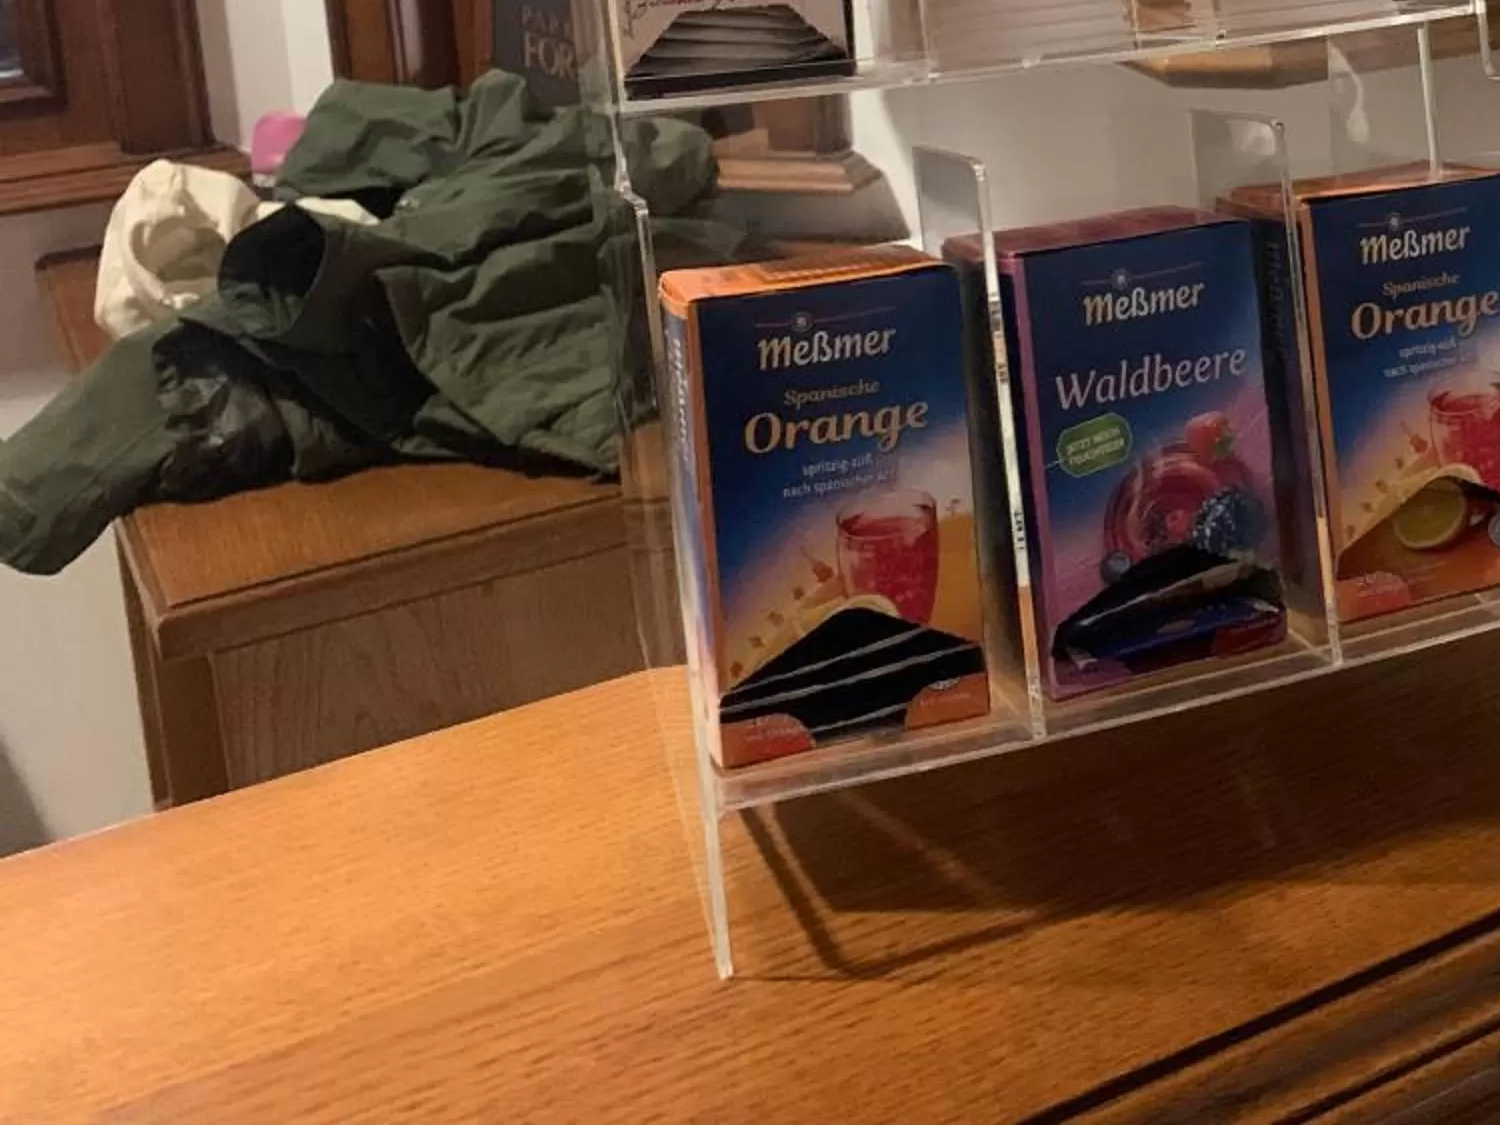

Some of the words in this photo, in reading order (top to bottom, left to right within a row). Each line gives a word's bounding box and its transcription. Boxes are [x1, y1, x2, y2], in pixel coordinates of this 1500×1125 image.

[1359, 225, 1471, 265] Meßmer
[1082, 283, 1206, 326] Meßmer
[1381, 271, 1461, 300] Spanische
[1351, 290, 1500, 340] Orange
[757, 327, 897, 372] Meßmer
[783, 378, 881, 410] Spanische
[1055, 348, 1247, 411] Waldbeere
[744, 400, 929, 455] Orange
